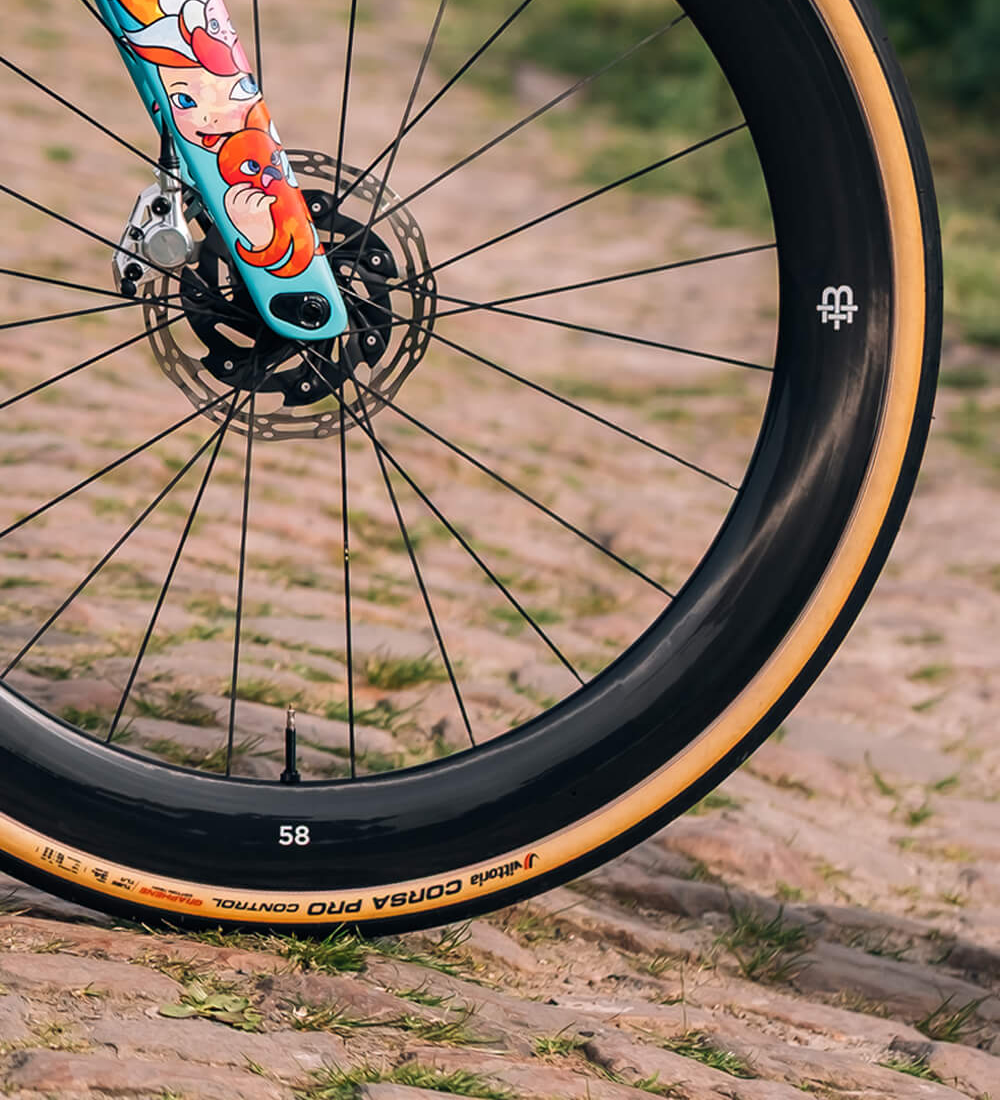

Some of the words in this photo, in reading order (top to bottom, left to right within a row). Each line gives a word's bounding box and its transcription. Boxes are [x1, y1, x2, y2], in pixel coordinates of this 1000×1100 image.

[278, 825, 311, 846] 58
[469, 859, 523, 887] vittoria
[372, 877, 463, 910] CORSA
[210, 897, 300, 913] CONTROL
[307, 898, 363, 916] PRO
